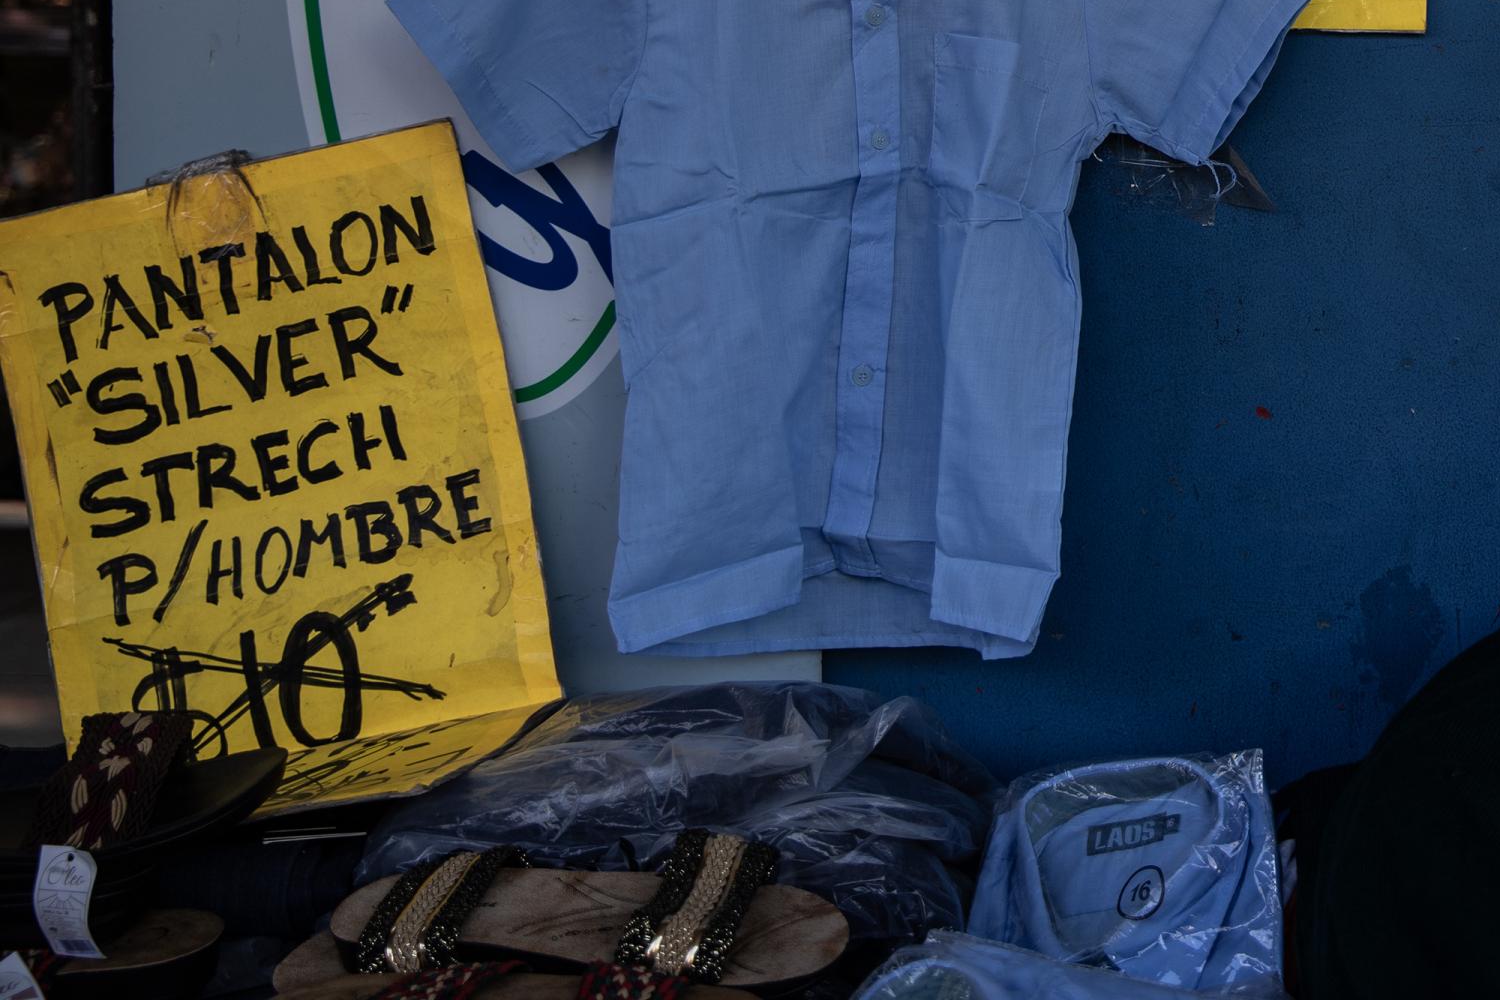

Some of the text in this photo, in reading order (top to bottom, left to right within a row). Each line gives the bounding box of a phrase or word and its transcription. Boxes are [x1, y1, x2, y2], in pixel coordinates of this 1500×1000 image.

[38, 195, 437, 364] PANTALON
[78, 404, 408, 539] STRECH
[98, 468, 493, 626] P/HOMBRE
[1094, 819, 1157, 851] LAOS
[1129, 878, 1153, 903] 16
